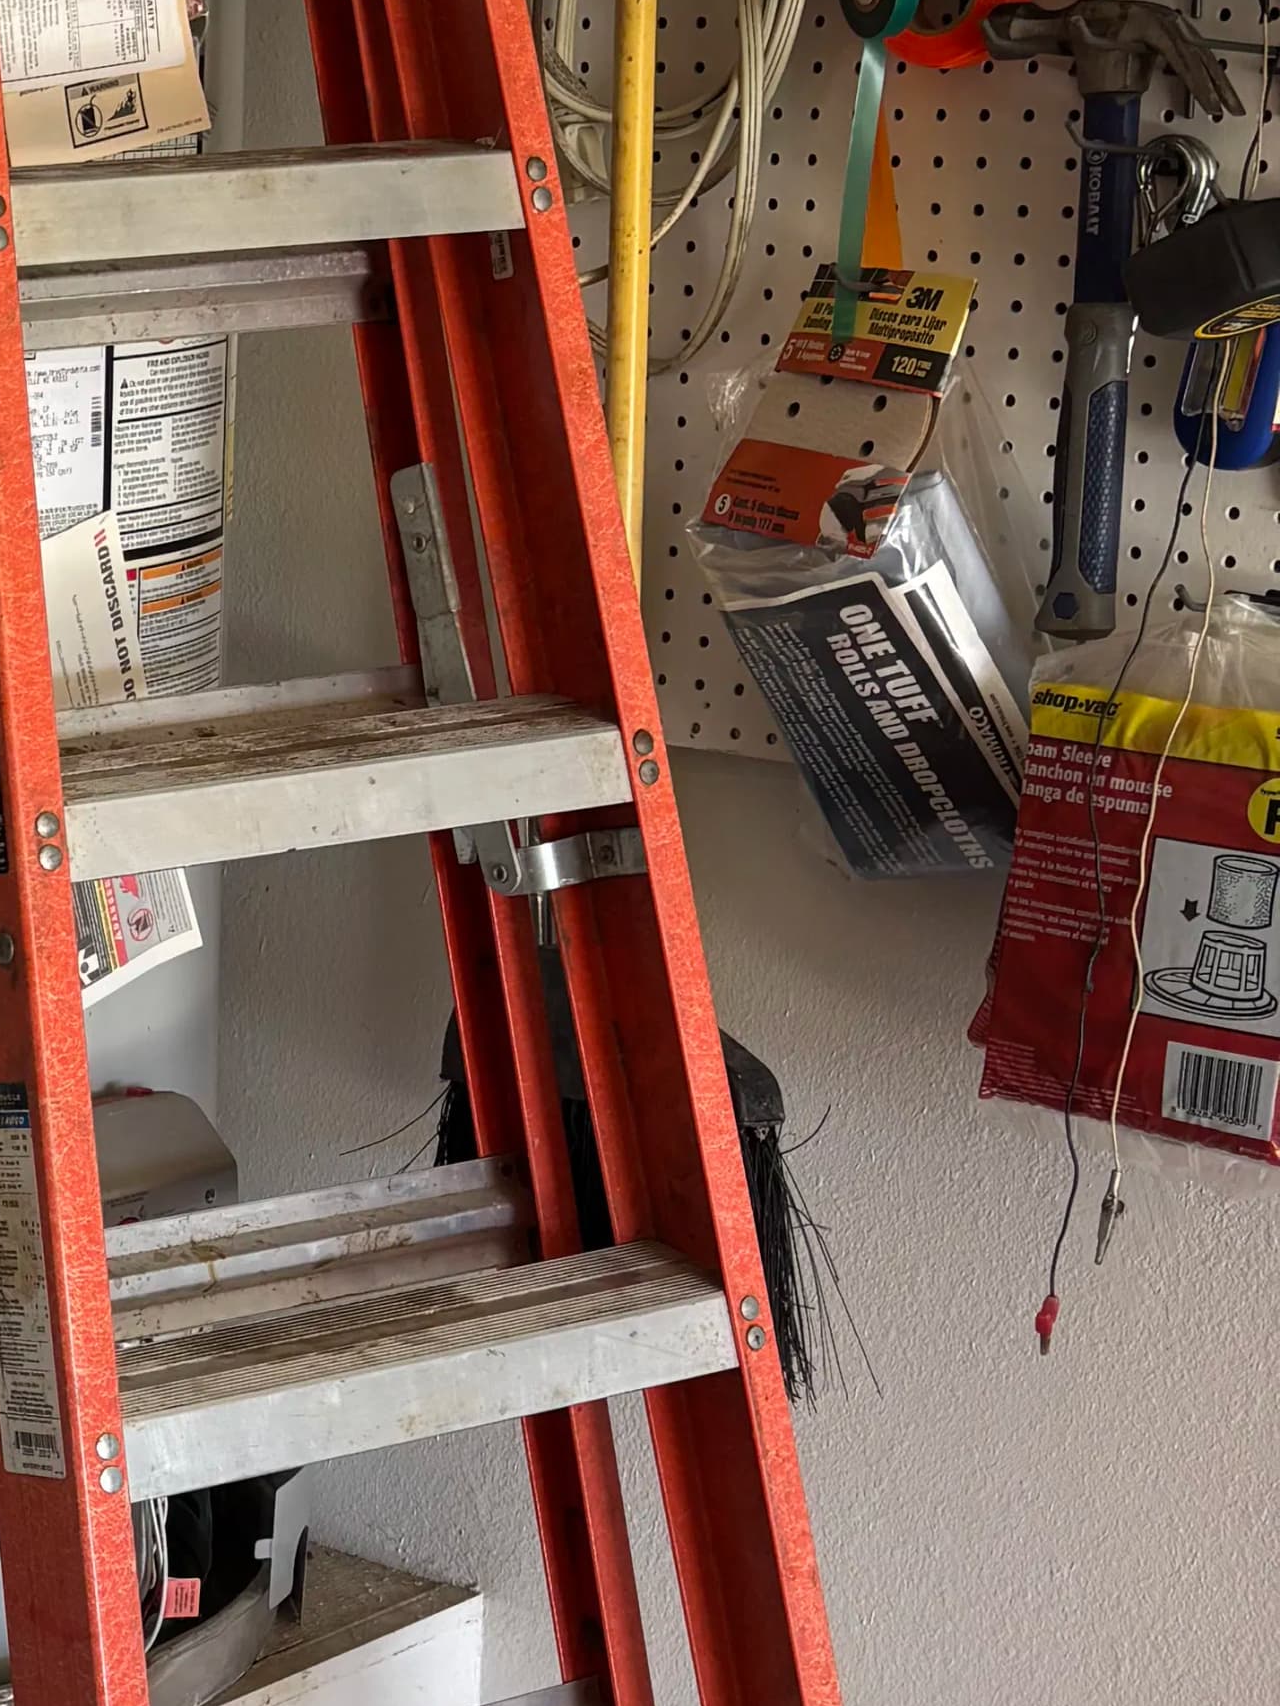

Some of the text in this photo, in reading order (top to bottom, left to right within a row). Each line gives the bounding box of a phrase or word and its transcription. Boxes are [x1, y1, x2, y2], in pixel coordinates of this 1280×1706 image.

[1087, 166, 1101, 236] KOBALT
[906, 282, 943, 314] 3M
[869, 304, 948, 336] Discos para Lijar
[890, 353, 917, 375] 120
[96, 544, 131, 671] NOT DISCARD
[837, 603, 937, 728] ONE TUFF
[825, 632, 995, 871] ROLLS AND DROPCLOTHS
[1026, 743, 1112, 768] oam Sleeve
[1022, 780, 1149, 814] anga de espuma
[1024, 764, 1173, 798] anchon en mousse
